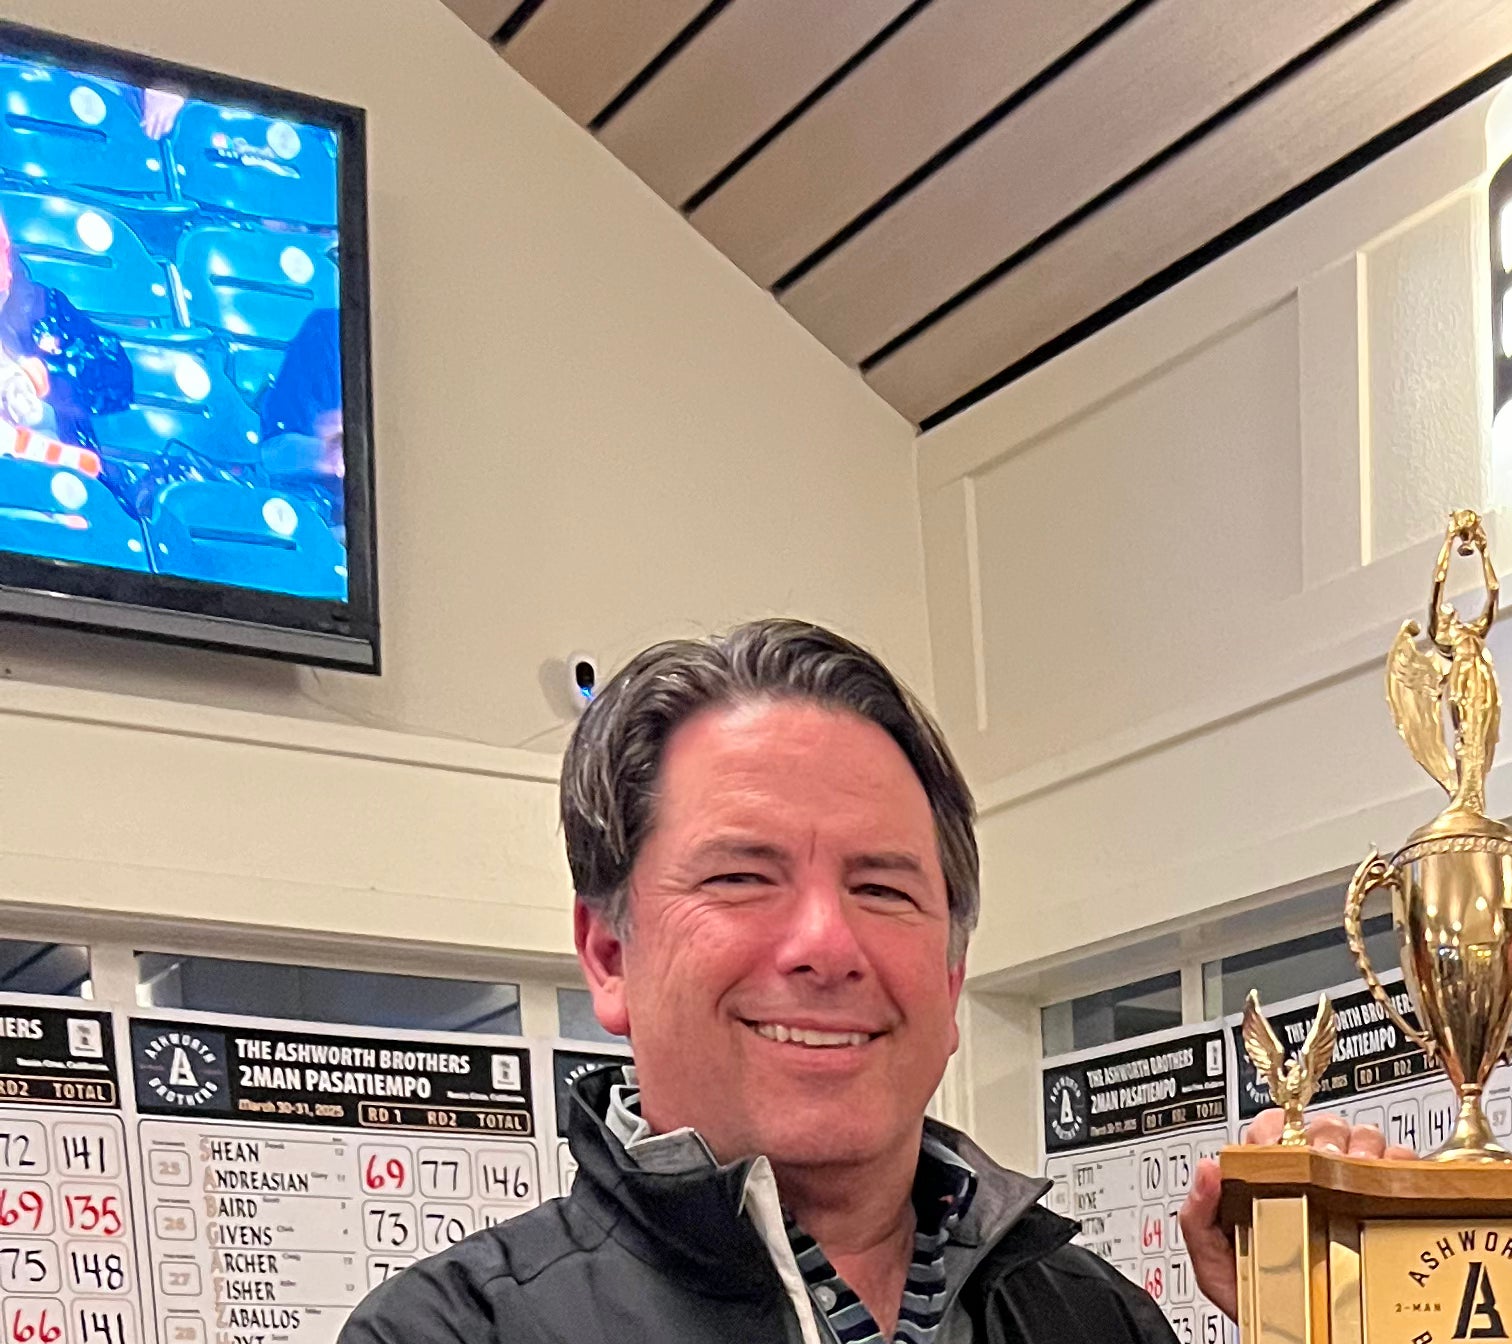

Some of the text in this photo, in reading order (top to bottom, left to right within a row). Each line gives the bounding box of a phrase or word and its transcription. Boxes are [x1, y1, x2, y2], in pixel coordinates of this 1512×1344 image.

[235, 1038, 471, 1074] THE ASHWORTH BROTHERS
[1332, 1026, 1396, 1063] ASATIEMPO
[53, 1082, 106, 1101] TOTAL
[239, 1065, 301, 1090] 2MAN
[305, 1069, 431, 1099] PASATIEMPO
[367, 1106, 523, 1130] RD 1 RD2 TOTAL
[63, 1135, 105, 1174] 141
[200, 1137, 260, 1162] SHEAN
[203, 1166, 309, 1192] ANDREASIAN
[366, 1154, 530, 1198] 69 77 146
[65, 1195, 121, 1236] 135
[204, 1194, 258, 1219] BAIRD
[206, 1221, 273, 1247] GIVENS
[368, 1209, 409, 1246] 73
[425, 1214, 465, 1245] 70
[71, 1250, 124, 1291] 148
[210, 1250, 278, 1274] ARCHER
[213, 1277, 276, 1301] FISHER
[1395, 1303, 1442, 1313] 2-MAN
[12, 1308, 62, 1344] 66
